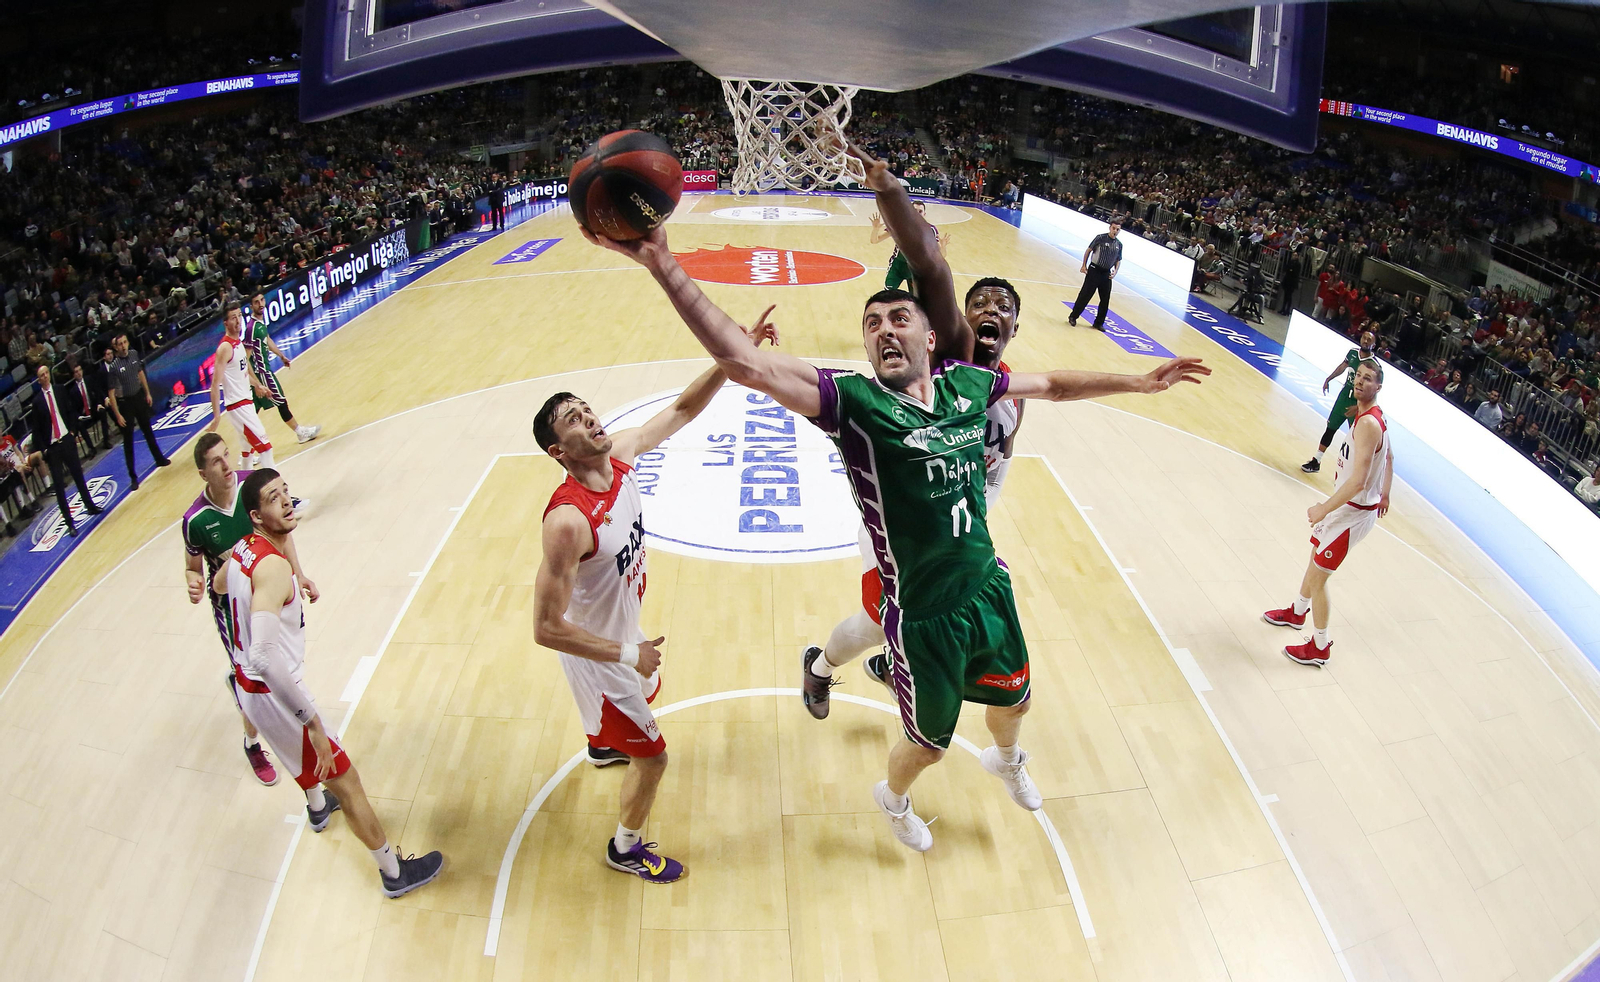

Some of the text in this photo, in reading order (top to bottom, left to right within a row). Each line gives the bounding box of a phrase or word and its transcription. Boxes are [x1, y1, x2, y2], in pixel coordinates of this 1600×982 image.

[149, 89, 166, 98] second
[166, 88, 179, 96] place
[206, 77, 254, 94] BENAHAVIS
[70, 100, 114, 116] Tu segundo lugar
[150, 96, 165, 104] world
[95, 107, 113, 117] mundo
[1376, 110, 1392, 118] second
[1392, 113, 1405, 121] place
[1377, 116, 1391, 124] world
[0, 116, 51, 145] NAHAVIS
[1436, 123, 1499, 150] BENAHAVIS
[1525, 147, 1551, 160] segundo
[1551, 154, 1567, 165] lugar
[1531, 155, 1567, 172] en el mundo
[683, 173, 716, 183] desa
[532, 181, 568, 199] mejo
[908, 186, 935, 195] Unicaja
[299, 284, 310, 305] a
[329, 253, 370, 288] mejor
[371, 241, 394, 269] liga
[744, 250, 780, 284] worten
[1211, 325, 1256, 347] de
[942, 424, 984, 447] Unicaja
[702, 433, 737, 467] LAS
[738, 392, 804, 533] PEDRIZAS
[951, 496, 973, 538] 11
[615, 511, 645, 578] BAX
